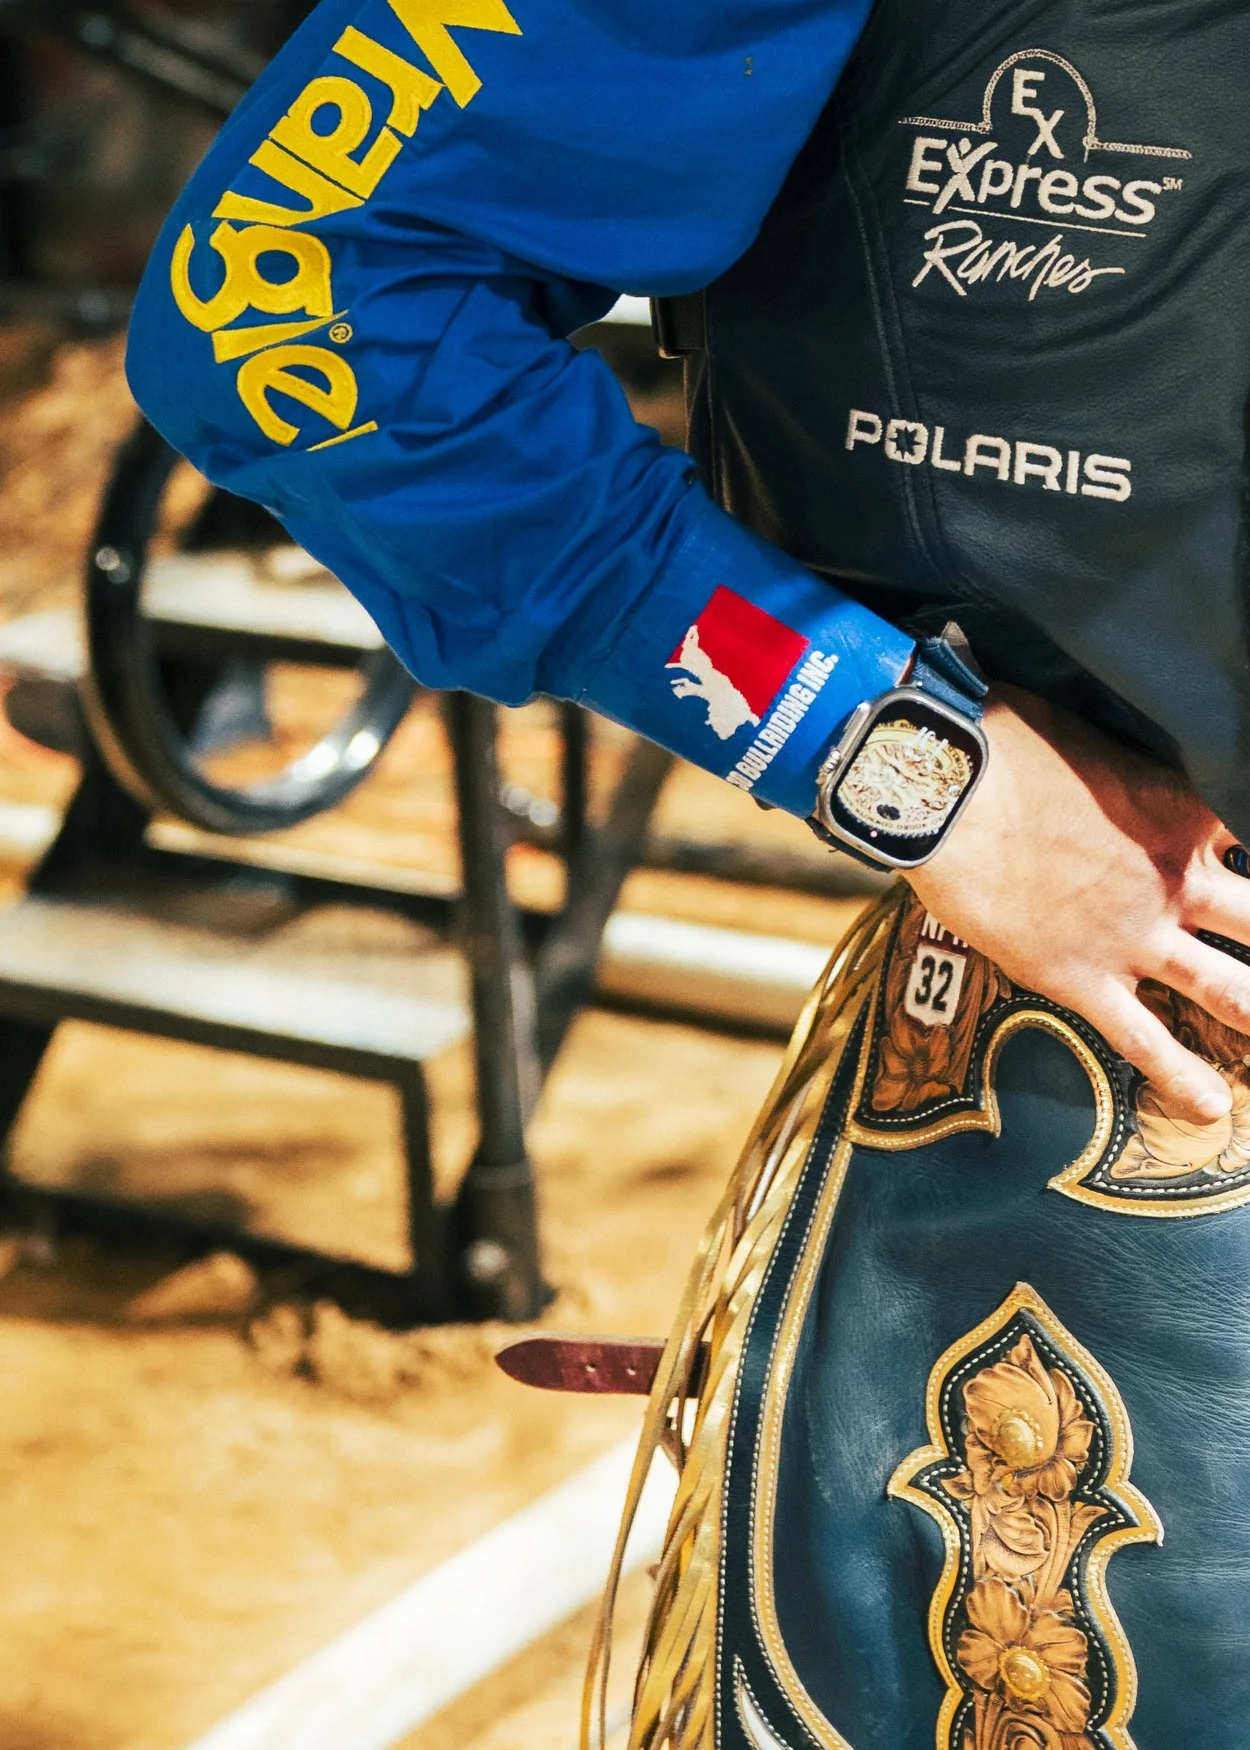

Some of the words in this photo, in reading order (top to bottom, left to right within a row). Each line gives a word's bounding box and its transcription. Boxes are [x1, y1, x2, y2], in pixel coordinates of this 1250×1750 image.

[911, 219, 1126, 302] Ranches
[845, 408, 1132, 502] POLARIS
[796, 650, 839, 693] INC.
[915, 954, 954, 1012] 32
